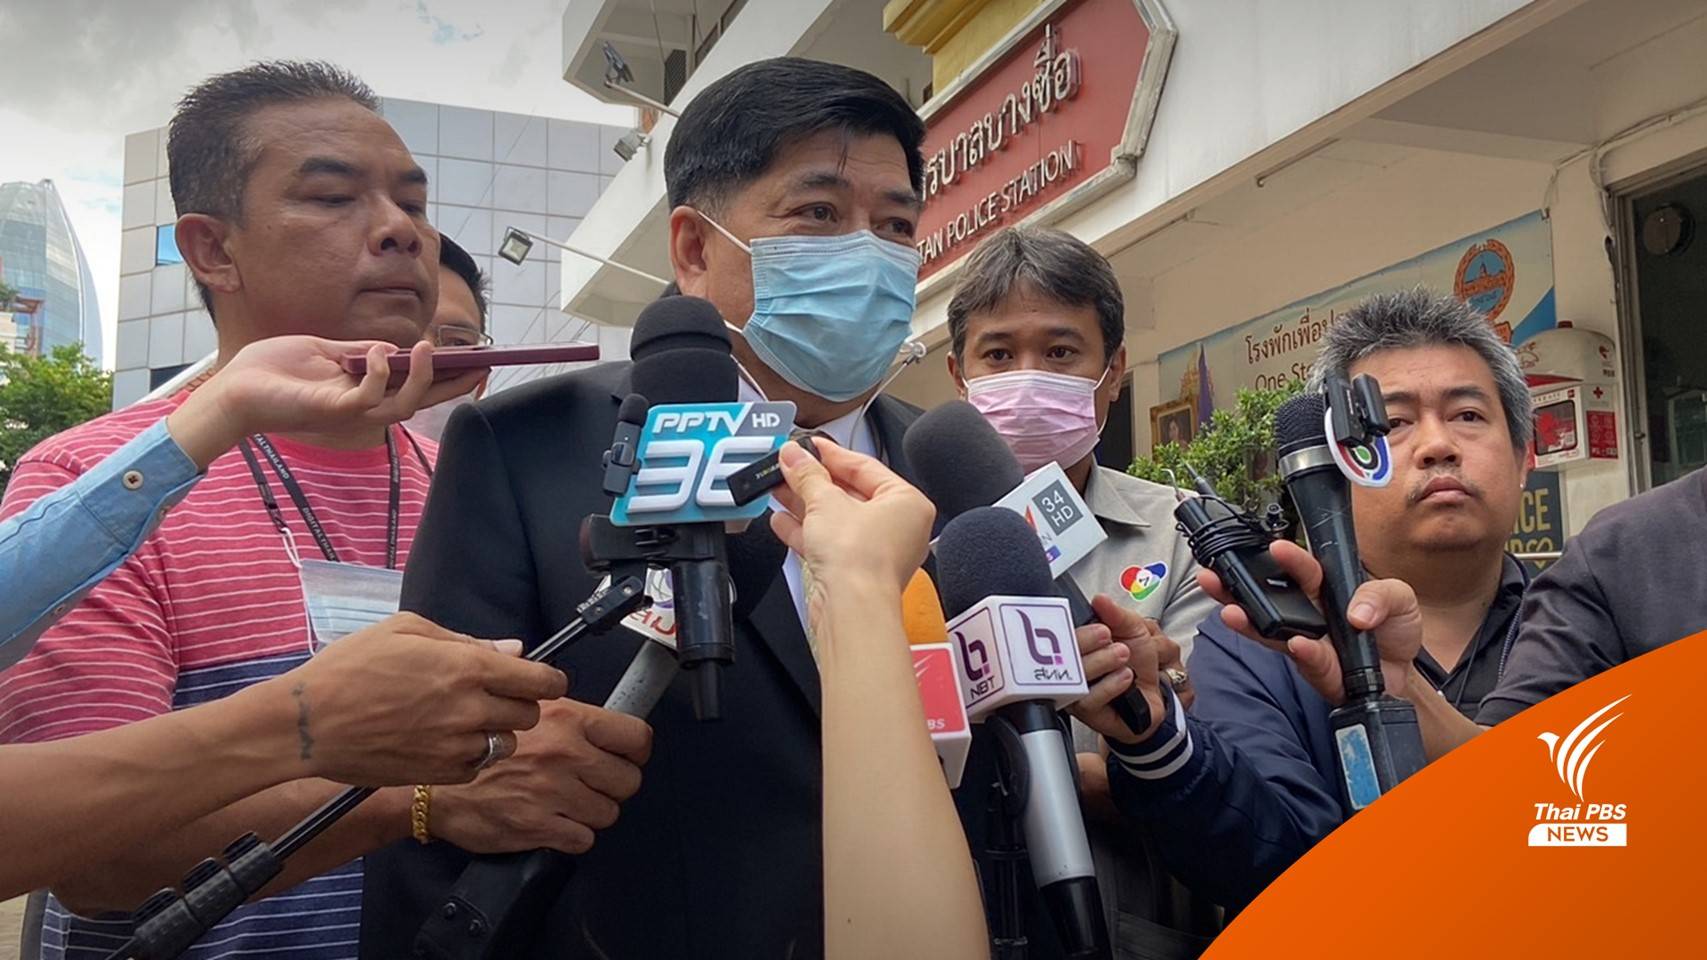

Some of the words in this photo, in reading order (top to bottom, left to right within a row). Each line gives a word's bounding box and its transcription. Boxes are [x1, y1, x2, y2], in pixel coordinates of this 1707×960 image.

[948, 192, 998, 247] POLICE
[1001, 140, 1074, 213] STATION
[652, 406, 752, 435] PPTV
[752, 412, 780, 428] HD
[1041, 489, 1065, 513] 34
[1051, 505, 1074, 527] HD
[970, 676, 995, 699] NBT
